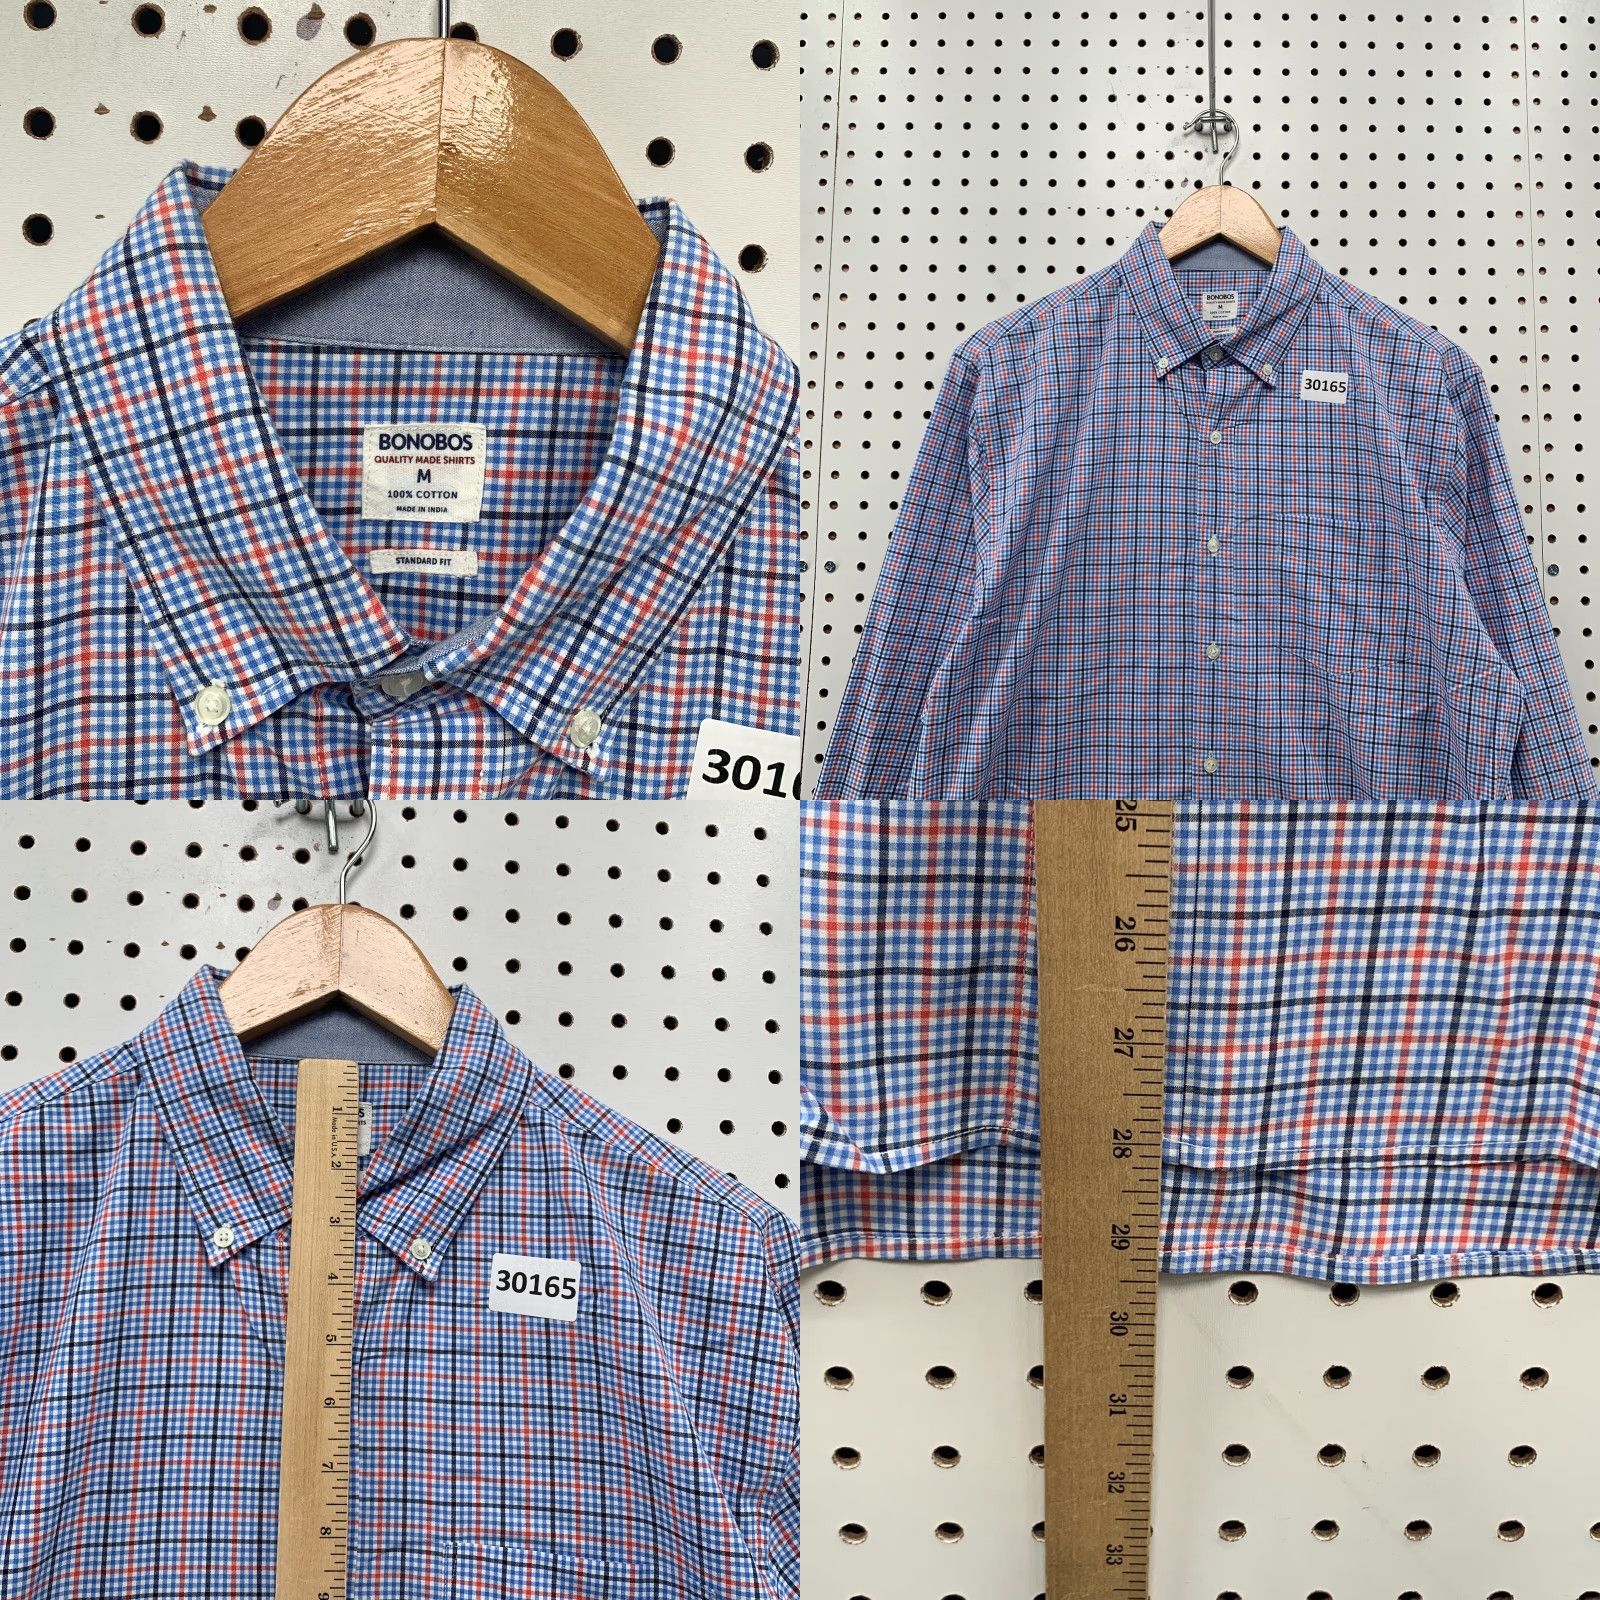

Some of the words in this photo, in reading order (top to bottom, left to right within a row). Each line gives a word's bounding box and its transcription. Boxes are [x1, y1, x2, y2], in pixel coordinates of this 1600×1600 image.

[1304, 378, 1347, 393] 30165
[378, 433, 473, 451] BONOBOS
[374, 455, 413, 464] QUALITY
[415, 456, 441, 464] MADE
[443, 456, 476, 465] SHIRTS
[416, 469, 432, 483] M
[387, 490, 413, 499] 100%
[416, 490, 458, 499] COTTON
[396, 505, 416, 513] MADE
[395, 557, 438, 565] STANDARD
[440, 558, 452, 566] FIT
[702, 748, 800, 800] 301
[1114, 916, 1137, 953] 26
[1113, 1027, 1135, 1059] 27
[1112, 1128, 1133, 1159] 28
[331, 1160, 342, 1169] 2
[329, 1216, 341, 1224] 3
[1110, 1223, 1131, 1251] 29
[327, 1272, 339, 1281] 4
[495, 1269, 577, 1300] 30165
[1109, 1310, 1129, 1337] 30
[326, 1333, 337, 1343] 5
[324, 1397, 336, 1406] 6
[1108, 1392, 1128, 1417] 31
[321, 1462, 334, 1470] 7
[1107, 1470, 1126, 1495] 32
[320, 1526, 332, 1536] 8
[1106, 1543, 1124, 1566] 33
